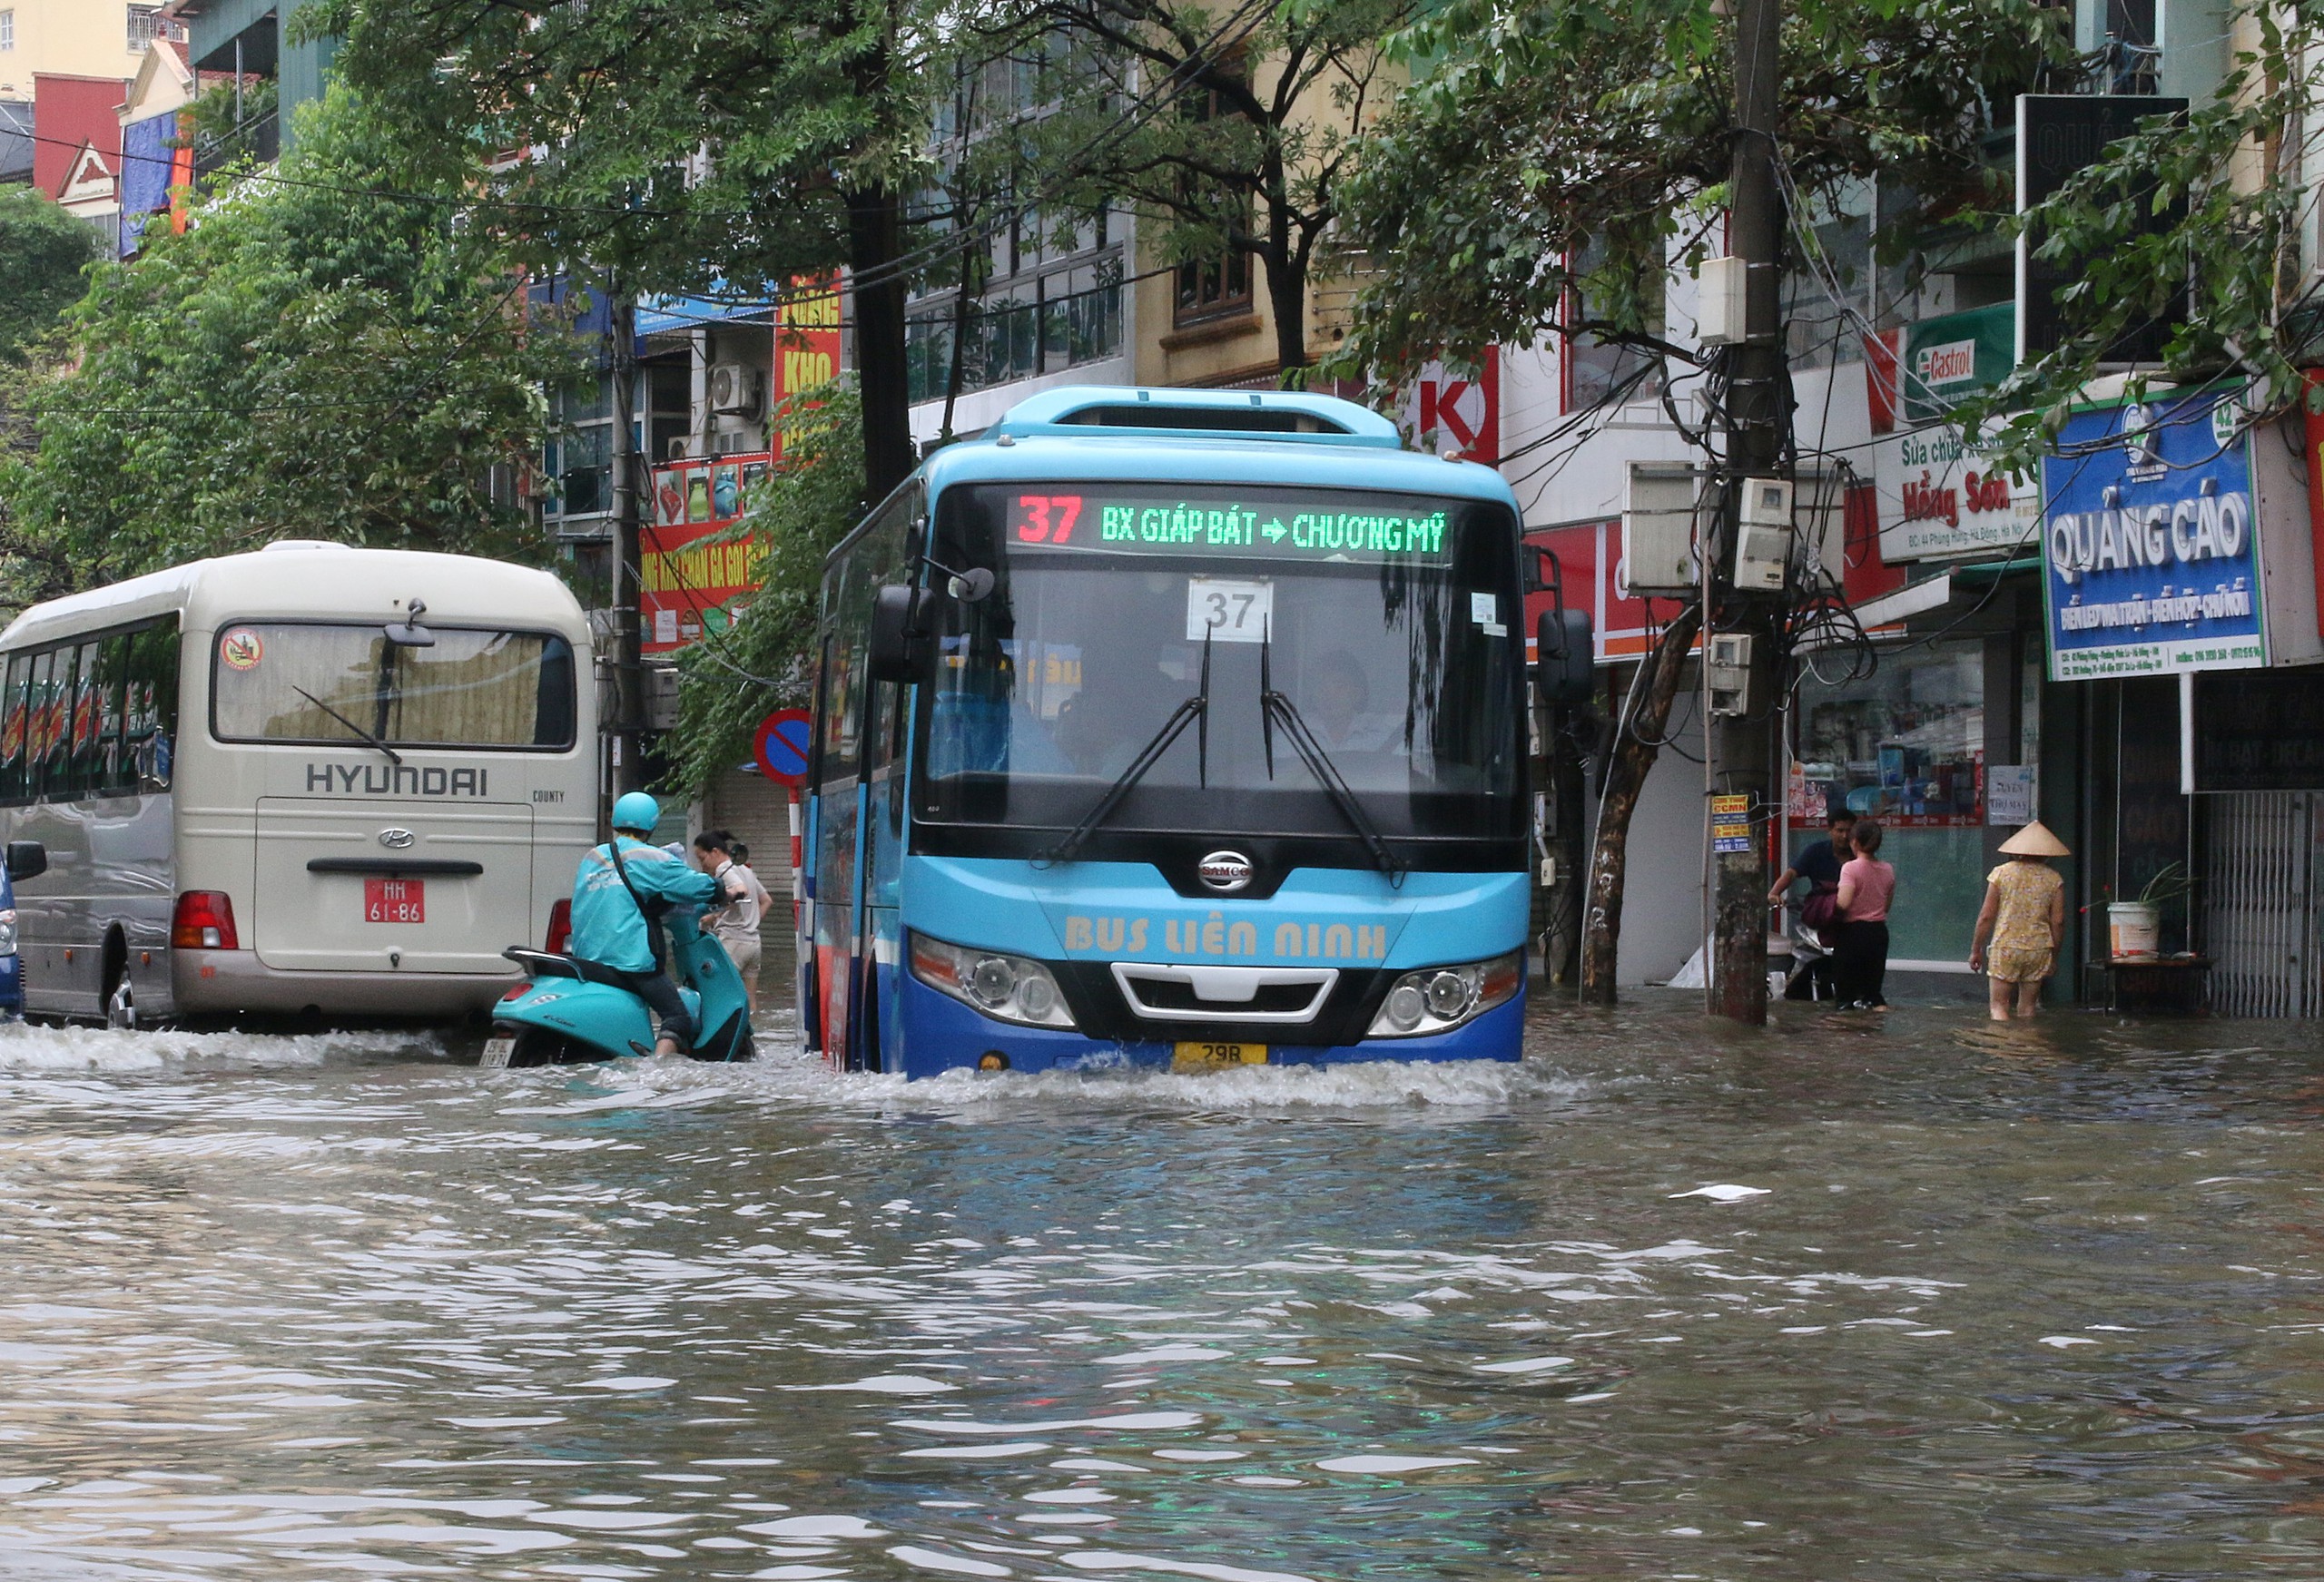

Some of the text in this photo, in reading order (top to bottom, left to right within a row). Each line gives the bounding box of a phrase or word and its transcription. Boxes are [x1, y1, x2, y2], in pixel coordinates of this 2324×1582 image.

[783, 350, 832, 393] KHO
[1930, 345, 1971, 381] Castrol
[1018, 496, 1445, 553] 37 BX GIÁP BÁT CHƯƠNG MỸ
[2051, 477, 2248, 585] QUẢNG CÁO
[1205, 592, 1256, 629] 37
[307, 763, 487, 797] HYUNDAI
[533, 790, 566, 803] COUNTY
[1202, 865, 1251, 877] SAMCO
[384, 881, 406, 900] HH
[370, 902, 420, 922] 61-86
[1065, 910, 1385, 959] BUS LIÊN NINH
